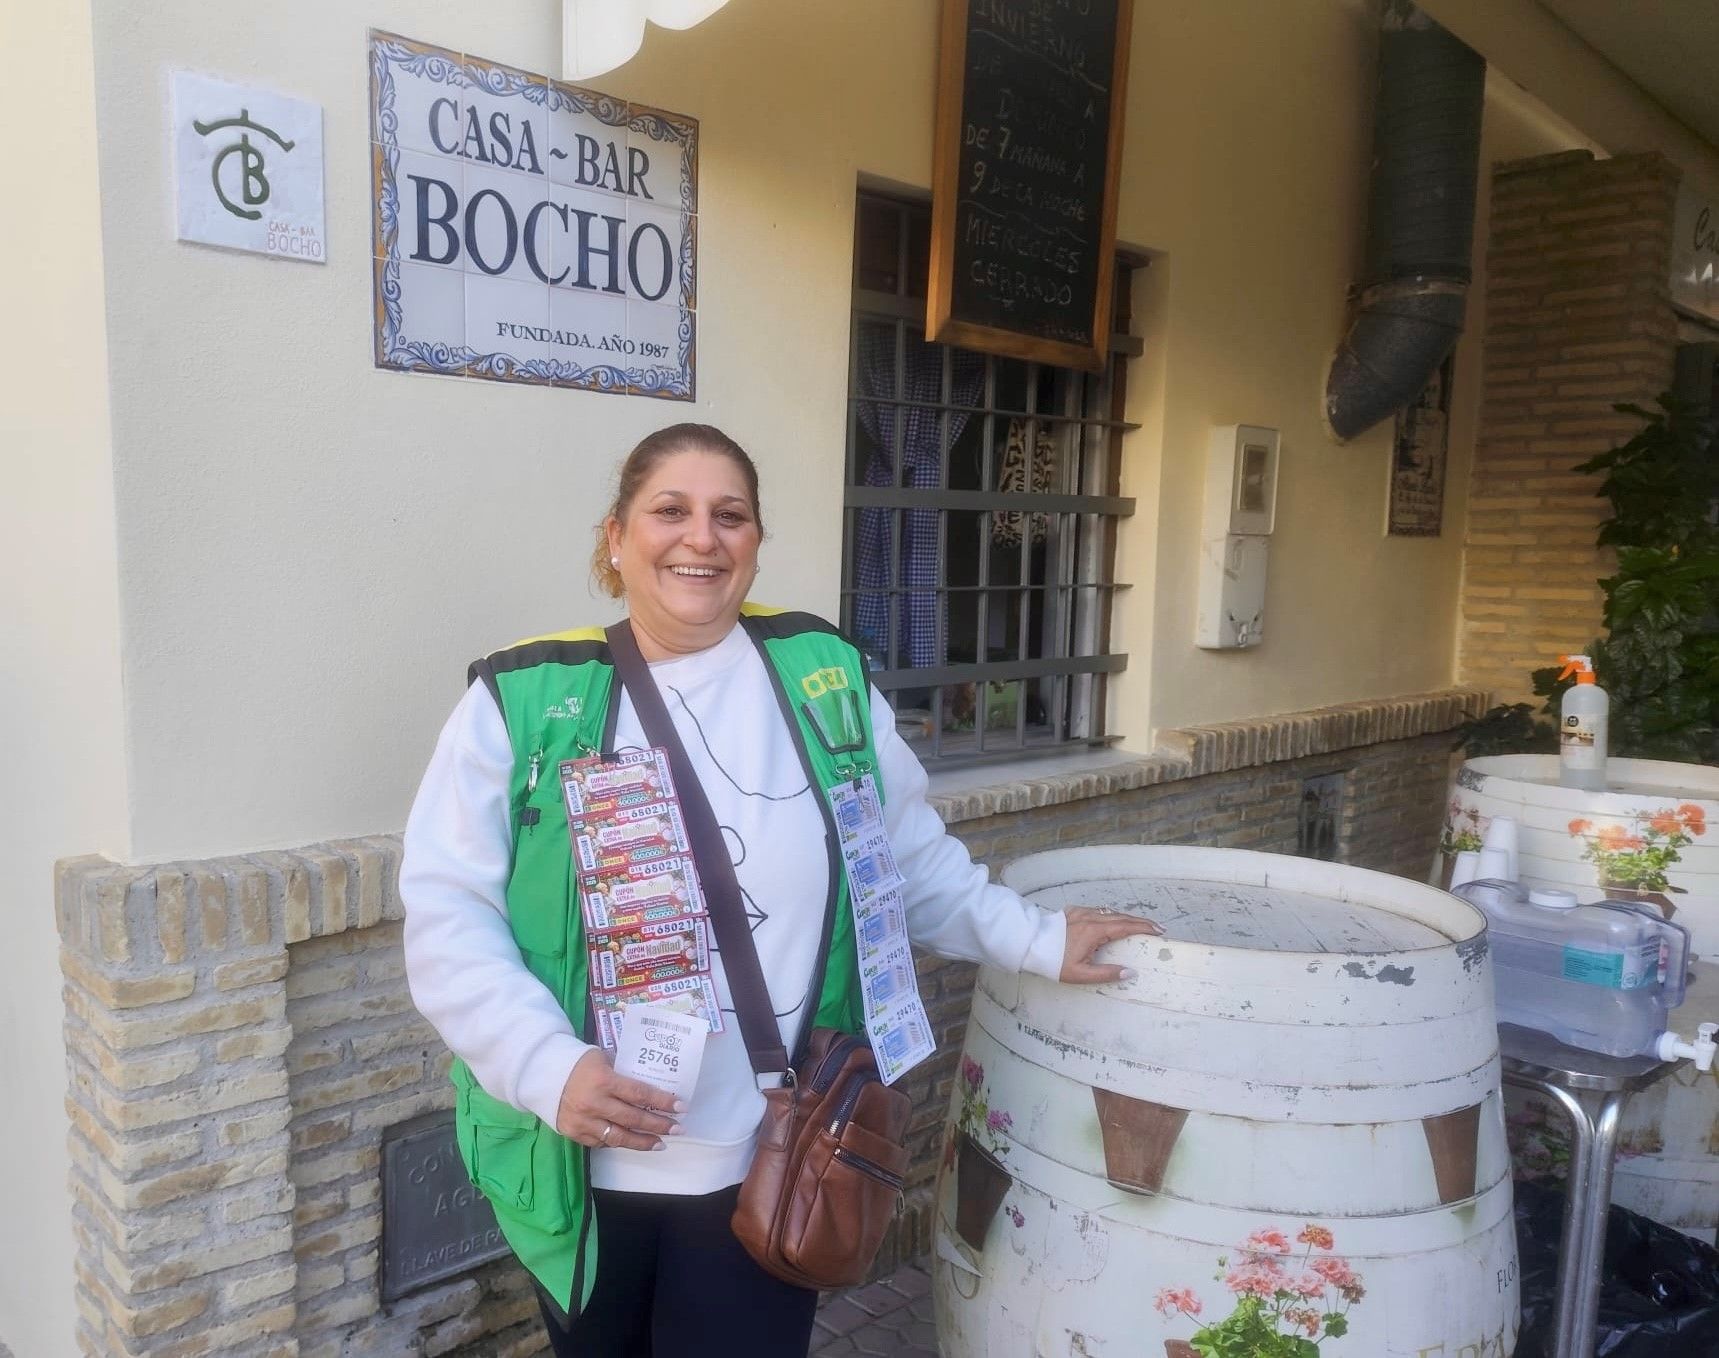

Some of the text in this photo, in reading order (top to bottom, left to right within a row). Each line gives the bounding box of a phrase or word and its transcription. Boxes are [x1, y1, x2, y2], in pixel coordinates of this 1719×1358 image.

[428, 96, 545, 176] CASA
[573, 131, 654, 200] BAR
[969, 160, 988, 193] 9
[267, 231, 322, 258] BOCHO
[406, 173, 674, 302] BOCHO
[597, 333, 636, 356] AÑO
[638, 341, 671, 359] 1987
[619, 752, 653, 765] 68021
[631, 803, 667, 818] 68021
[644, 859, 679, 875] 68021
[656, 919, 692, 935] 68021
[625, 976, 643, 985] ONCE
[663, 977, 699, 994] 68021
[639, 1047, 679, 1067] 25766
[459, 1234, 482, 1255] DE
